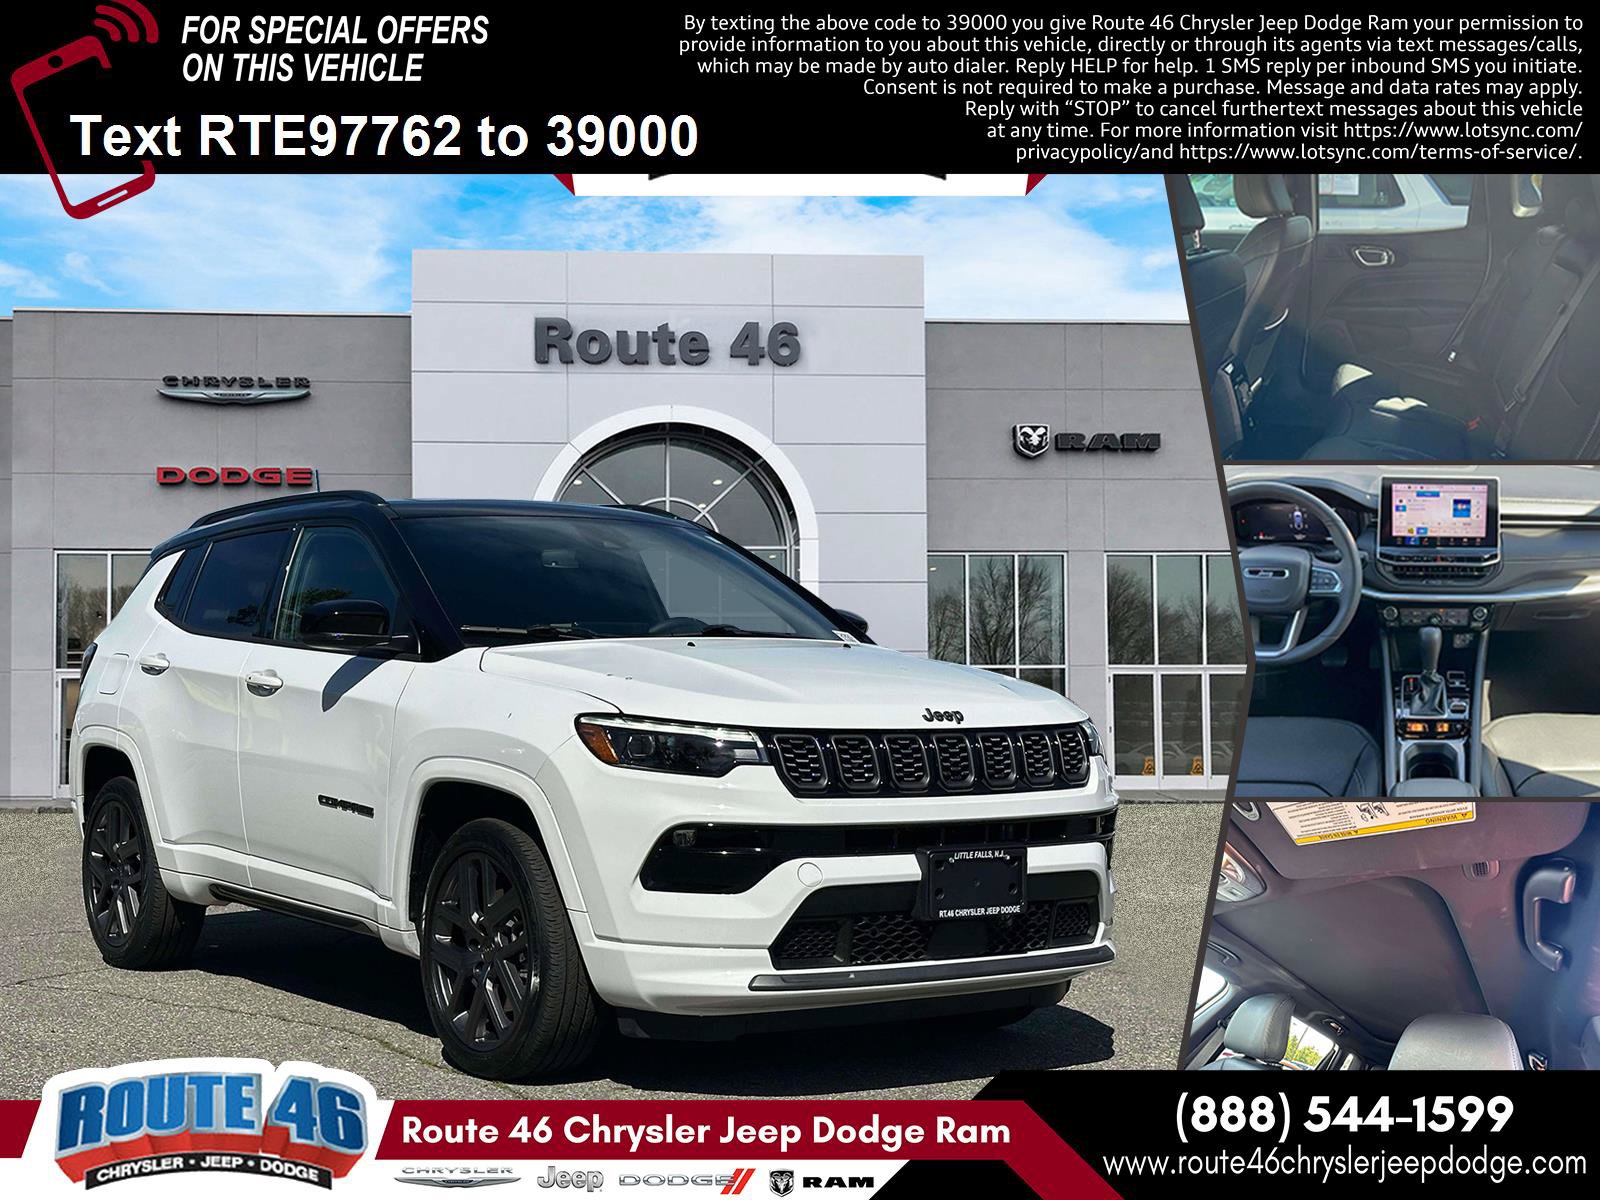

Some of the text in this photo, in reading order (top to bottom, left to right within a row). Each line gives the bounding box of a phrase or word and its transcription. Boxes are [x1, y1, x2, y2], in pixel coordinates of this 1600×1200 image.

[534, 317, 801, 367] Route 46
[162, 374, 311, 388] CHRYSLER
[1054, 432, 1162, 452] RAM
[156, 466, 313, 487] DODGE
[921, 707, 965, 725] Jeep
[954, 851, 974, 860] LITTLE
[954, 907, 986, 917] CHRYSLER
[986, 906, 1001, 915] JEEP
[1001, 904, 1021, 914] DODGE
